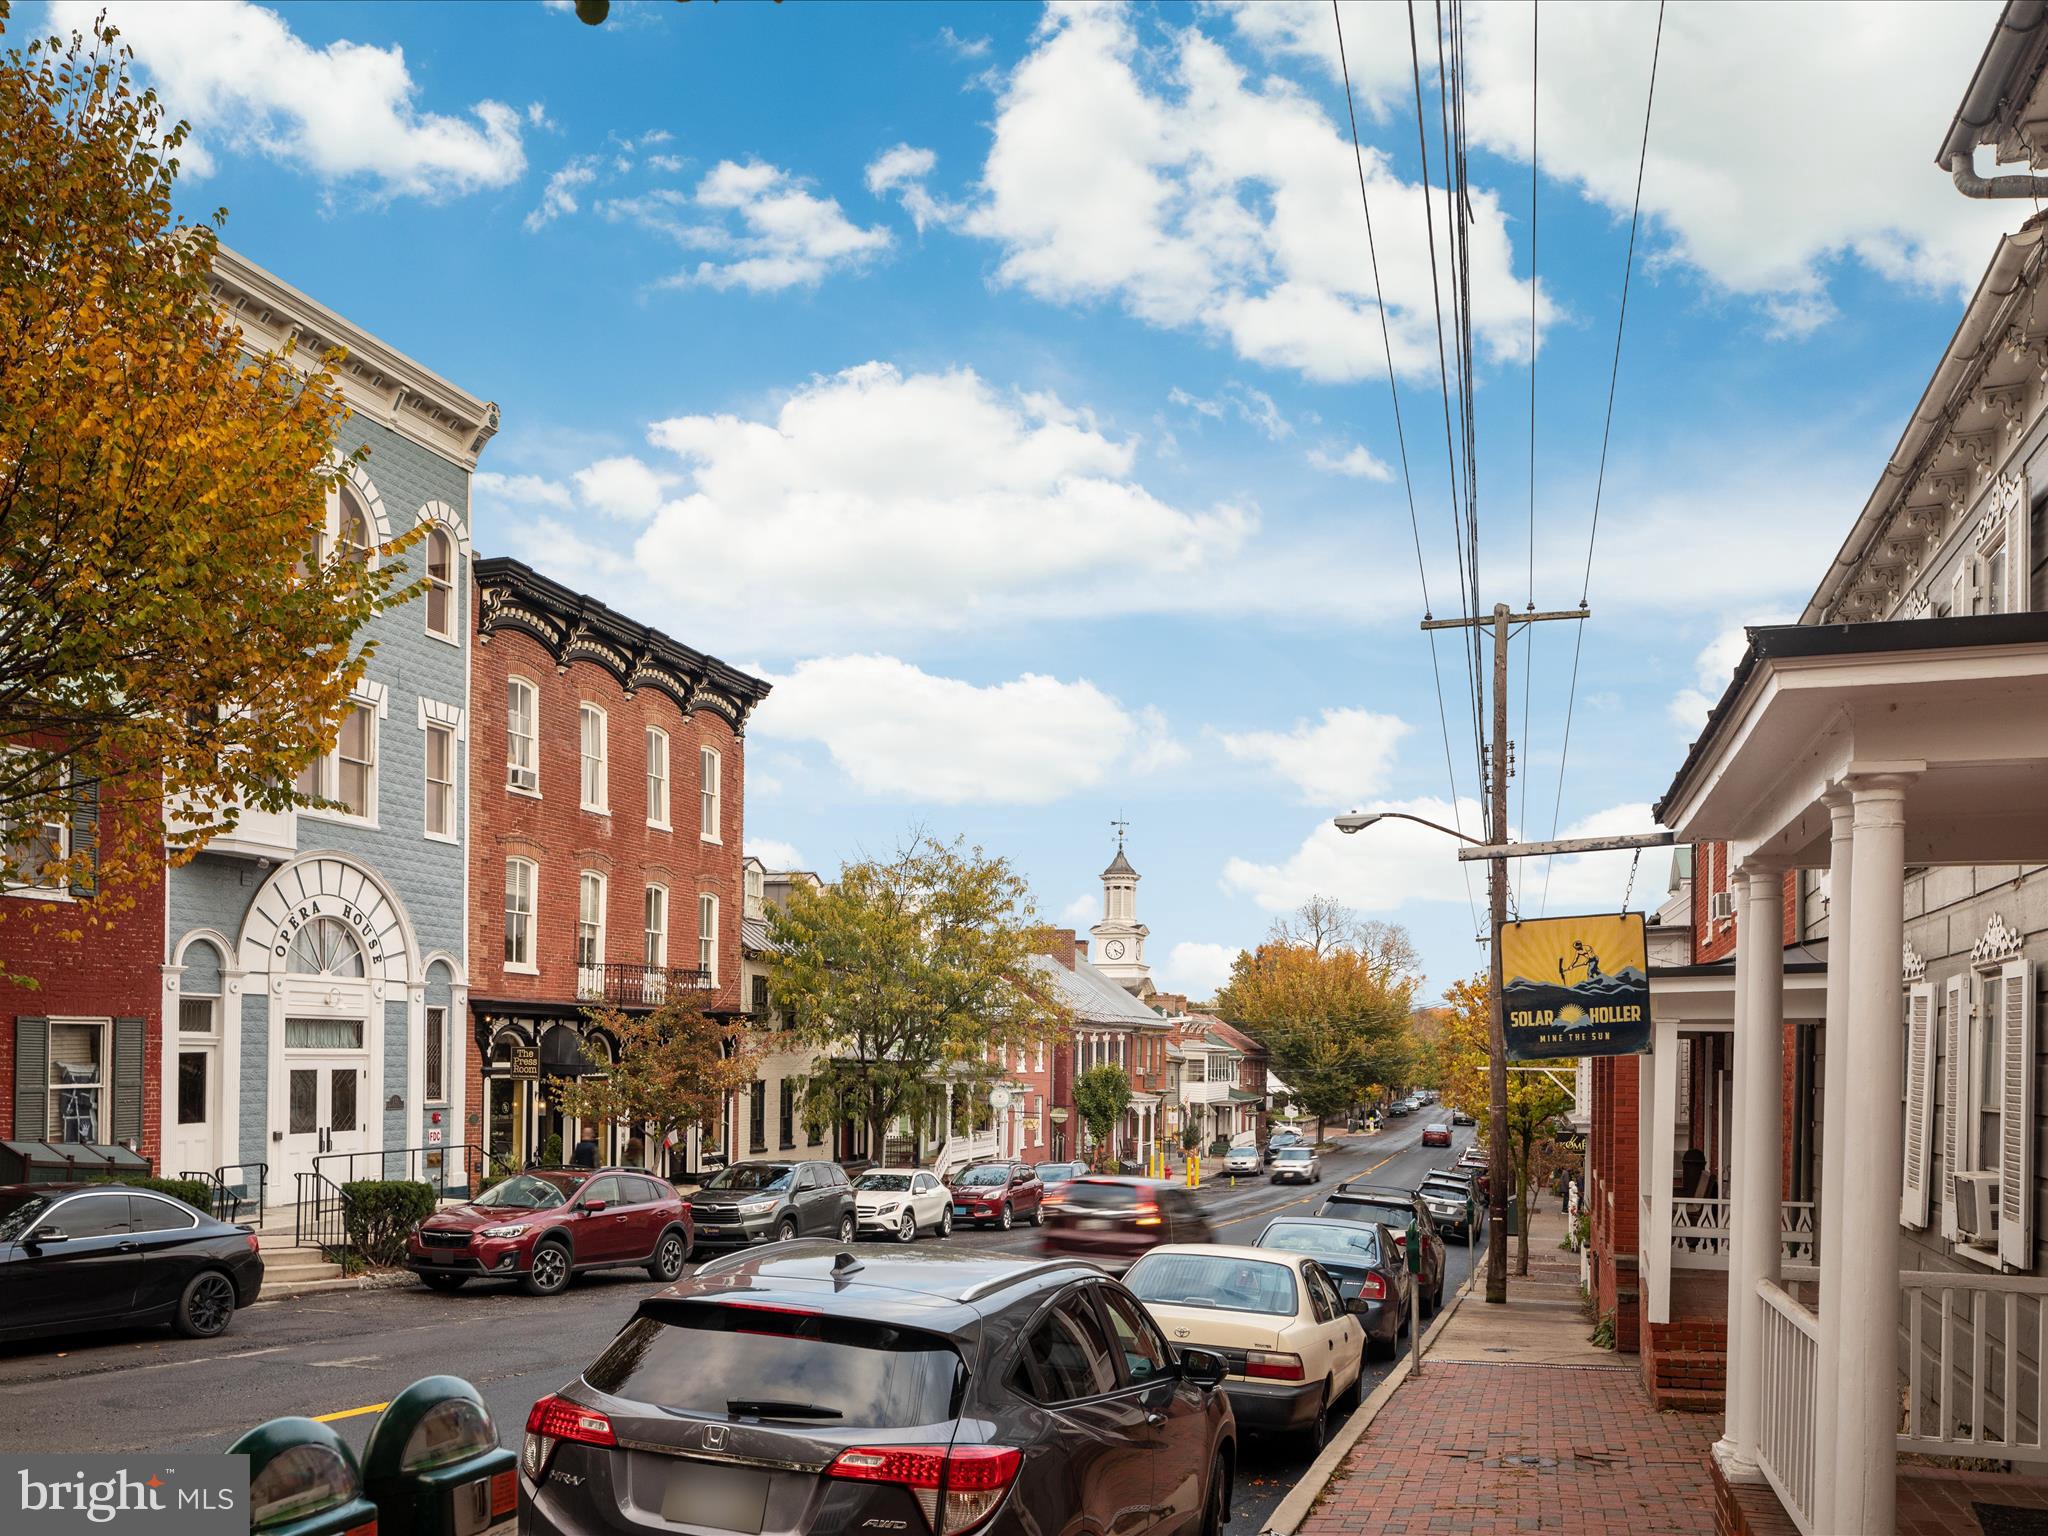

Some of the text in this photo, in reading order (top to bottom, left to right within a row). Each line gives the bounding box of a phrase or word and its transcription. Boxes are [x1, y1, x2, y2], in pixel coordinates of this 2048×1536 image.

[275, 901, 382, 965] OPERA HOUSE
[1510, 1005, 1641, 1027] SOLAR HOLLER
[1540, 1032, 1610, 1042] MINE THE SUN
[517, 1049, 534, 1057] The
[513, 1057, 538, 1066] Press
[513, 1065, 538, 1073] Room
[430, 1131, 440, 1141] FDC
[862, 1519, 907, 1530] AWD
